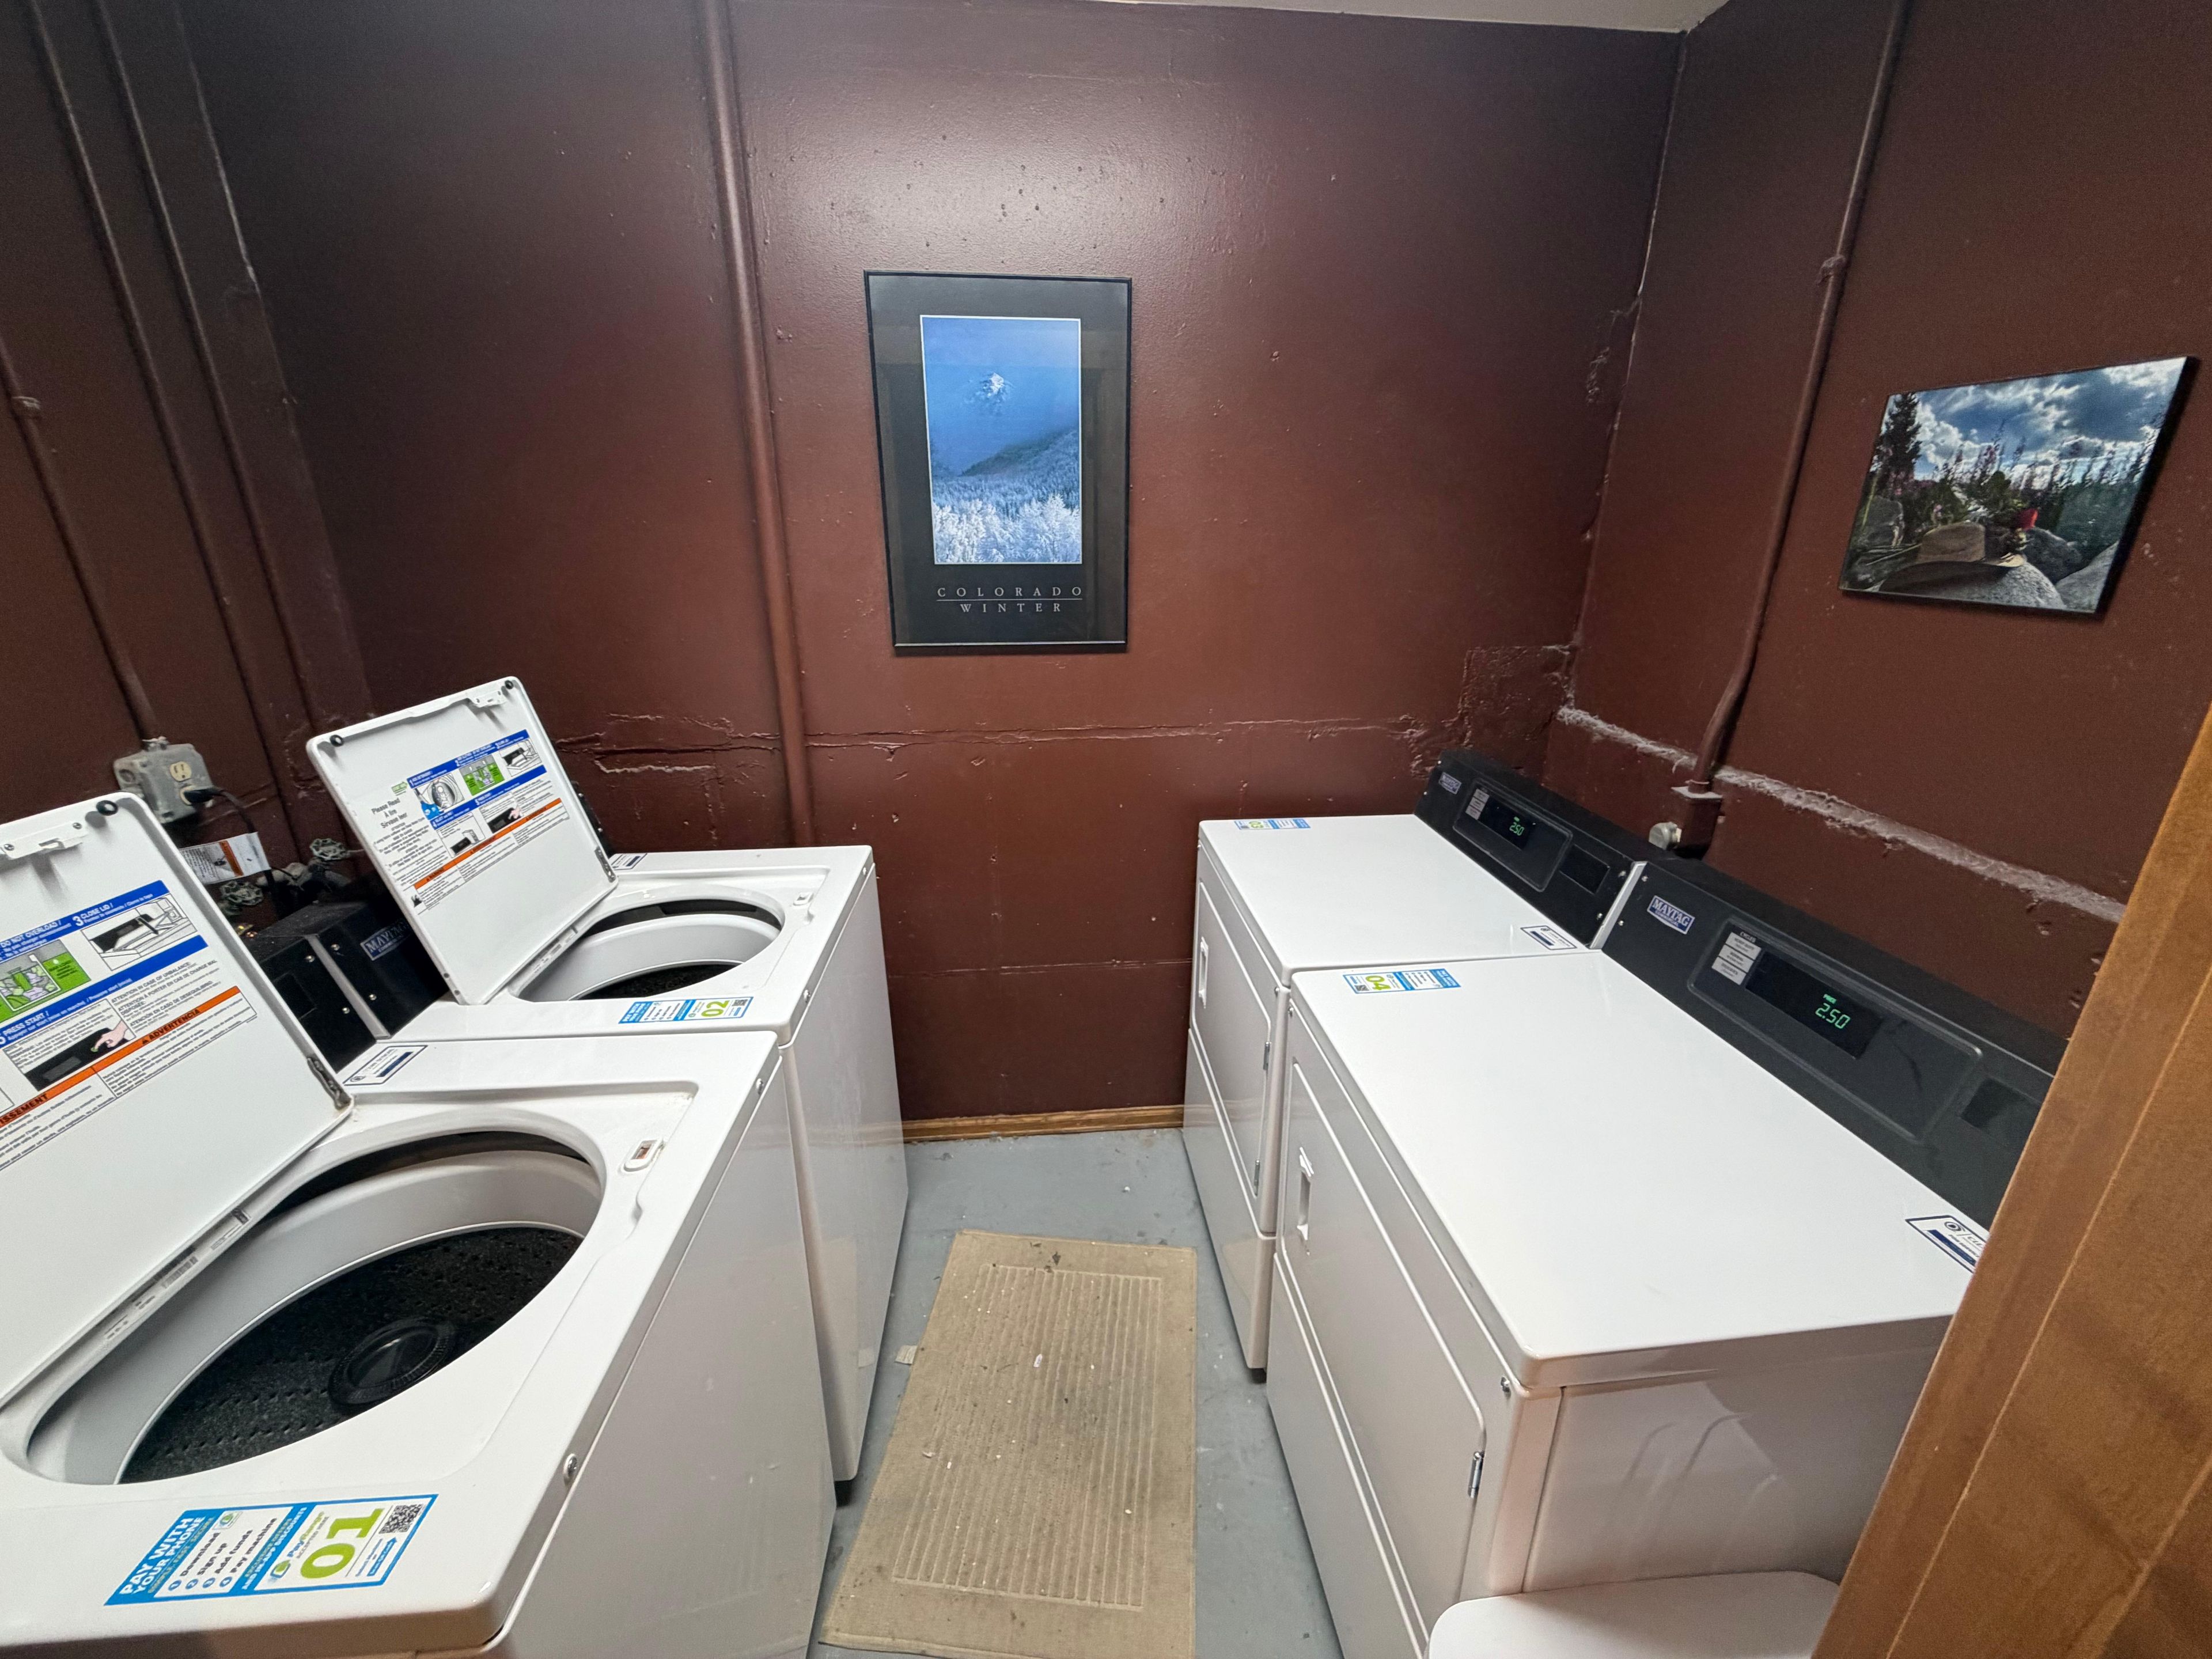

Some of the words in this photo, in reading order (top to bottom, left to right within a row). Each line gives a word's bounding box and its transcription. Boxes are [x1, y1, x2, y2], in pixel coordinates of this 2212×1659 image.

[937, 586, 1082, 597] COLORADO
[960, 603, 1060, 612] WINTER
[73, 916, 84, 926] 3
[79, 907, 101, 919] CLOSE
[98, 903, 111, 912] LID
[1652, 899, 1690, 927] MAYTAG
[365, 922, 410, 953] MAYTA
[110, 987, 138, 1003] ATTENTION
[142, 978, 156, 987] CASE
[1365, 975, 1392, 991] 04
[117, 995, 145, 1012] ATTENTION
[701, 1000, 730, 1017] 02
[1815, 1002, 1850, 1029] 2.50
[2, 1022, 26, 1037] PRESS
[24, 1012, 46, 1026] START
[147, 1007, 200, 1040] ADVERTENCIA
[0, 1094, 47, 1124] ISSEMENT
[119, 1564, 153, 1594] PAY
[149, 1518, 195, 1560] WITH
[131, 1558, 171, 1594] YOUR
[165, 1516, 206, 1556] PHONE
[180, 1532, 221, 1576] Download
[214, 1556, 232, 1573] Add
[229, 1529, 253, 1554] funds
[230, 1557, 248, 1573] Pay
[245, 1518, 277, 1554] machine
[241, 1573, 257, 1590] AND
[274, 1507, 308, 1546] DISCOUNTS
[300, 1508, 385, 1578] 01
[197, 1556, 217, 1575] Sign
[214, 1543, 228, 1554] up
